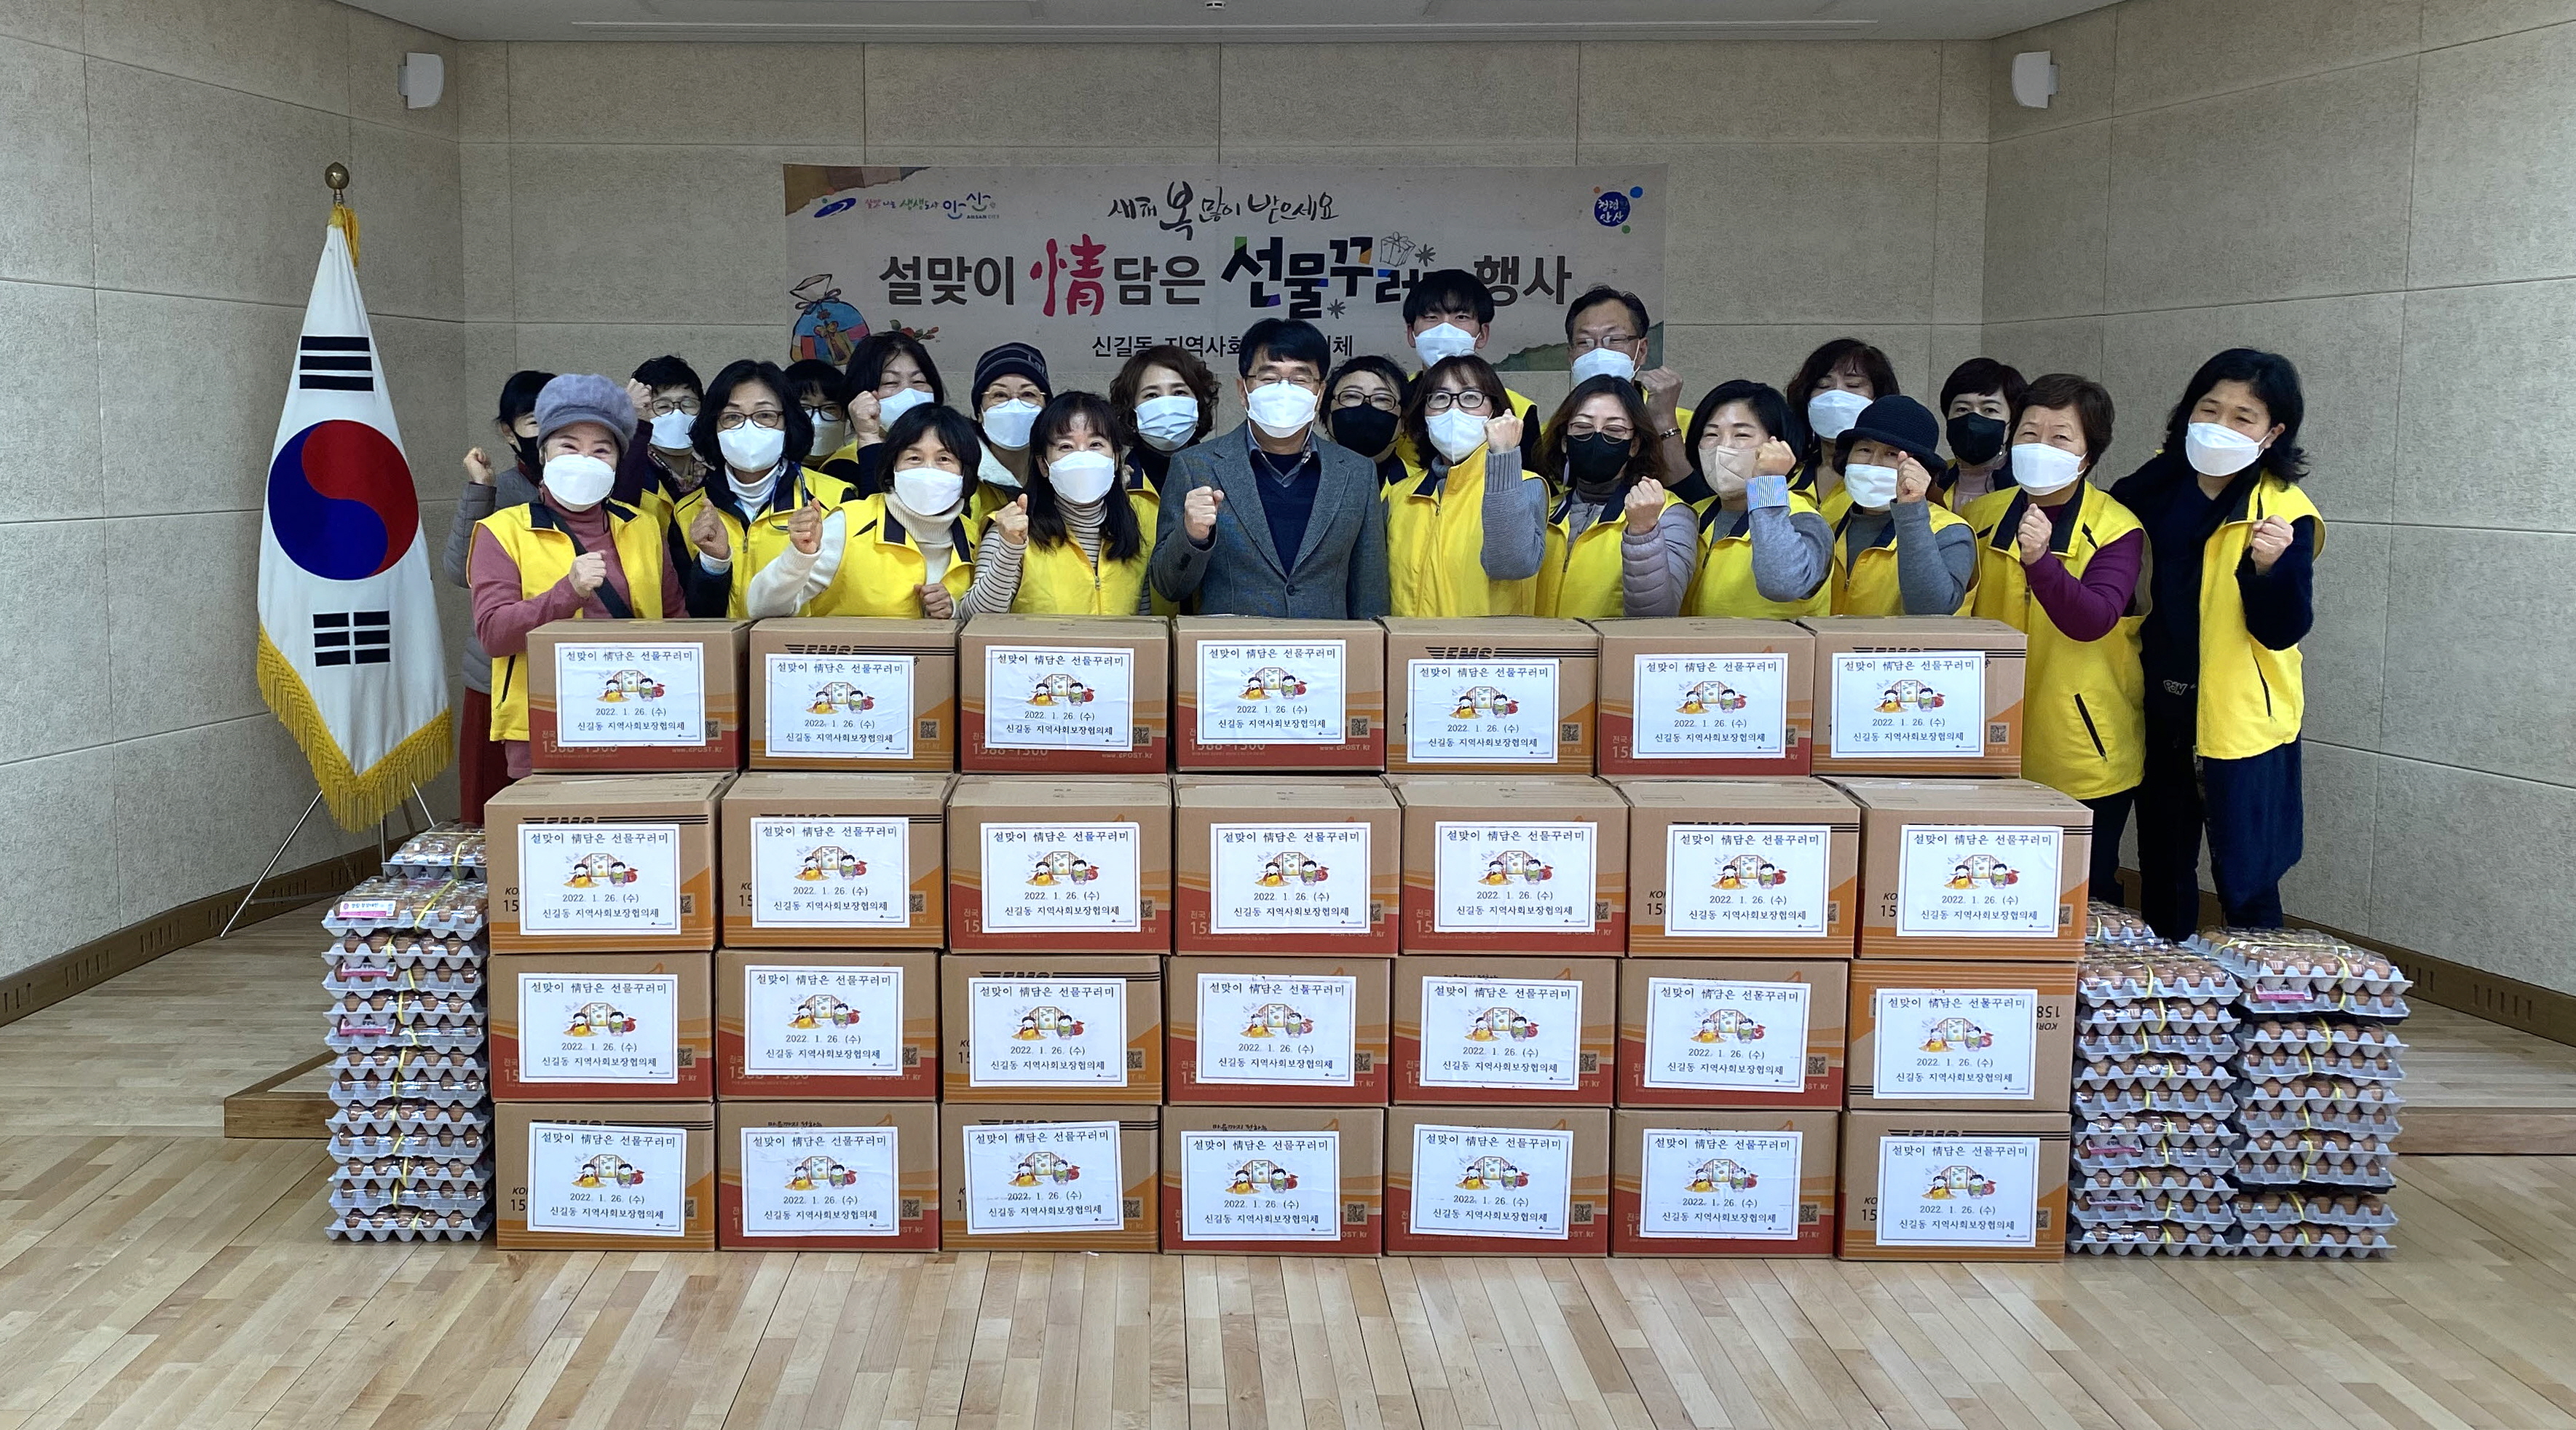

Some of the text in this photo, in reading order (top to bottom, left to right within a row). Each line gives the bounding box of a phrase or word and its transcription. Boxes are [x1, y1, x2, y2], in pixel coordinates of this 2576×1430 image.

[1107, 181, 1338, 241] 새해 복 많이 받으세요
[879, 255, 1014, 306] 설맞이
[1221, 235, 1434, 320] 선물꾸러
[1473, 255, 1572, 307] 행사
[1283, 648, 1335, 658] 선물꾸러미
[1921, 660, 1974, 671] 선물꾸러미
[1495, 666, 1548, 677] 선물꾸러미
[1218, 719, 1325, 728] 신길동 지역사회보장협의체
[1504, 724, 1519, 732] (수)
[1853, 732, 1964, 741] 신길동 지역사회보장협의체
[1429, 738, 1537, 747] 신길동 지역사회보장협의체
[762, 826, 897, 837] 설맞이 情담은 선물꾸러미
[993, 831, 1129, 842] 설맞이 情담은 선물꾸러미
[1223, 831, 1359, 842] 설맞이 情담은 선물꾸러미
[1447, 830, 1584, 842] 설맞이 情담은 선물꾸러미
[531, 832, 668, 844] 설맞이 情담은 선물꾸러미
[1680, 834, 1820, 845] 설맞이 情담은 선물꾸러미
[1913, 833, 2051, 846] 설맞이 情담은 선물꾸러미
[852, 886, 868, 896] (수)
[773, 901, 888, 911] 신길동 지역사회보장협의체
[2002, 896, 2018, 905] (수)
[542, 908, 658, 918] 신길동 지역사회보장협의체
[1004, 906, 1119, 915] 신길동 지역사회보장협의체
[1233, 906, 1349, 917] 신길동 지역사회보장협의체
[1456, 905, 1572, 915] 신길동 지역사회보장협의체
[1688, 910, 1806, 920] 신길동 지역사회보장협의체
[1920, 910, 2037, 920] 신길동 지역사회보장협의체
[756, 973, 890, 986] 설맞이 情담은 선물꾸러미
[531, 982, 666, 994] 설맞이 情담은 선물꾸러미
[980, 986, 1114, 998] 설맞이 情담은 선물꾸러미
[765, 1048, 880, 1059] 신길동 지역사회보장협의체
[1069, 1046, 1085, 1055] (수)
[542, 1056, 656, 1067] 신길동 지역사회보장협의체
[990, 1060, 1105, 1070] 신길동 지역사회보장협의체
[541, 1131, 675, 1147] 설맞이 情담은 선물꾸러미
[753, 1135, 885, 1147] 설맞이 情담은 선물꾸러미
[976, 1129, 1108, 1145] 설맞이 情담은 선물꾸러미
[1426, 1134, 1561, 1150] 설맞이 情담은 선물꾸러미
[1193, 1139, 1328, 1150] 설맞이 情담은 선물꾸러미
[1892, 1145, 2028, 1157] 설맞이 情담은 선물꾸러미
[1283, 1199, 1299, 1209] (수)
[550, 1206, 663, 1219] 신길동 지역사회보장협의체
[764, 1209, 877, 1220] 신길동 지역사회보장협의체
[989, 1204, 1102, 1217] 신길동 지역사회보장협의체
[1433, 1209, 1547, 1222] 신길동 지역사회보장협의체
[1204, 1214, 1319, 1223] 신길동 지역사회보장협의체
[1899, 1220, 2015, 1230] 신길동 지역사회보장협의체
